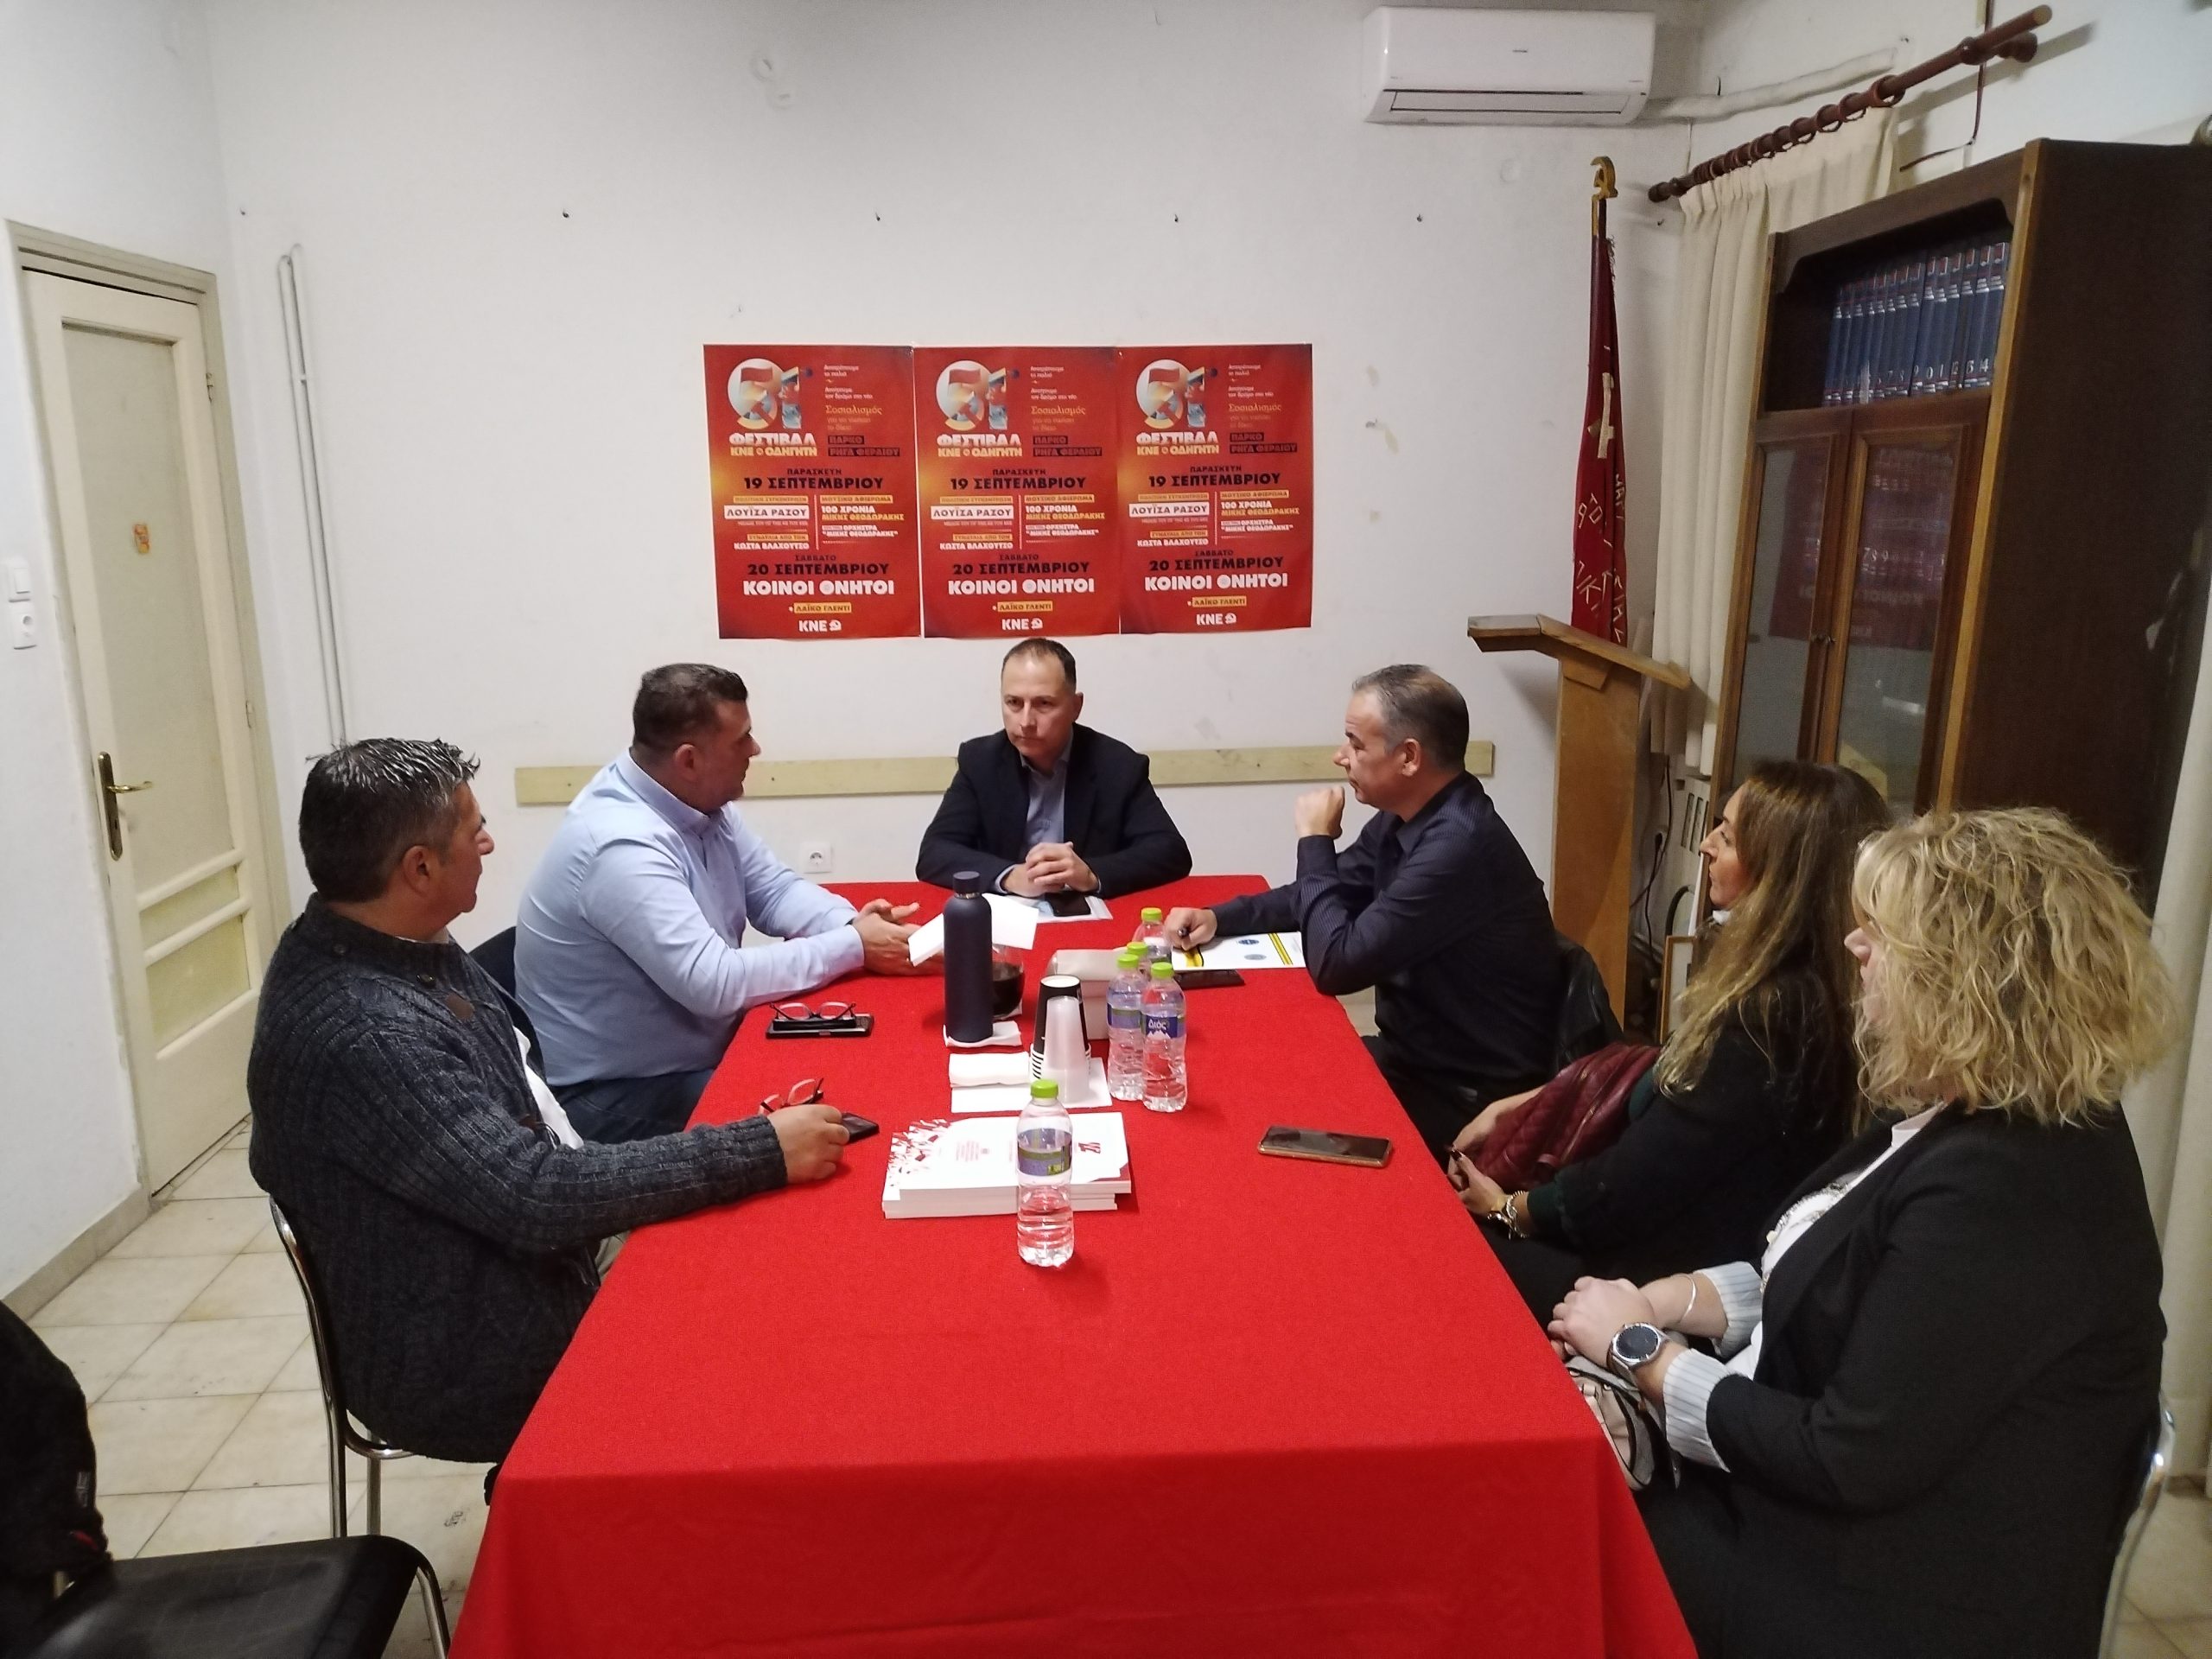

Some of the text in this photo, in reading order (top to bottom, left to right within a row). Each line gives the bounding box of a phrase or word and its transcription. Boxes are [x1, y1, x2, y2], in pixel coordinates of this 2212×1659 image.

[826, 404, 882, 416] Σοσιαλισμός
[1031, 405, 1085, 416] Σοσιαλισμός
[1229, 403, 1282, 412] Σοσιαλισμός
[729, 433, 816, 446] ΦΕΣΤΙΒΑΛ
[829, 435, 863, 444] ΠΑΡΚΟ
[937, 434, 1020, 447] ΦΕΣΤΙΒΑΛ
[1034, 435, 1066, 444] ΠΑΡΚΟ
[1135, 431, 1218, 444] ΦΕΣΤΙΒΑΛ
[1231, 433, 1262, 442] ΠΑΡΚΟ
[730, 447, 817, 456] ΚΝΕ ΟΔΗΓΗΤΗ
[938, 447, 1022, 457] ΚΝΕ ΟΔΗΓΗΤΗ
[1137, 444, 1219, 455] ΚΝΕ ΟΔΗΓΗΤΗ
[744, 477, 883, 489] 19 ΣΕΠΤΕΜΒΡΙΟΥ
[950, 477, 1086, 490] 19 ΣΕΠΤΕΜΒΡΙΟΥ
[1149, 473, 1281, 487] 19 ΣΕΠΤΕΜΒΡΙΟΥ
[747, 563, 889, 575] 20 ΣΕΠΤΕΜΒΡΙΟΥ
[953, 563, 1090, 575] 20 ΣΕΠΤΕΜΒΡΙΟΥ
[1149, 556, 1283, 571] 20 ΣΕΠΤΕΜΒΡΙΟΥ
[743, 580, 814, 595] ΚΟΙΝΟΙ
[948, 580, 1017, 594] ΚΟΙΝΟΙ
[1145, 575, 1212, 591] ΚΟΙΝΟΙ
[1002, 619, 1029, 630] ΚΝΕ
[1196, 613, 1224, 626] ΚΝΕ
[798, 620, 828, 632] ΚΝΕ
